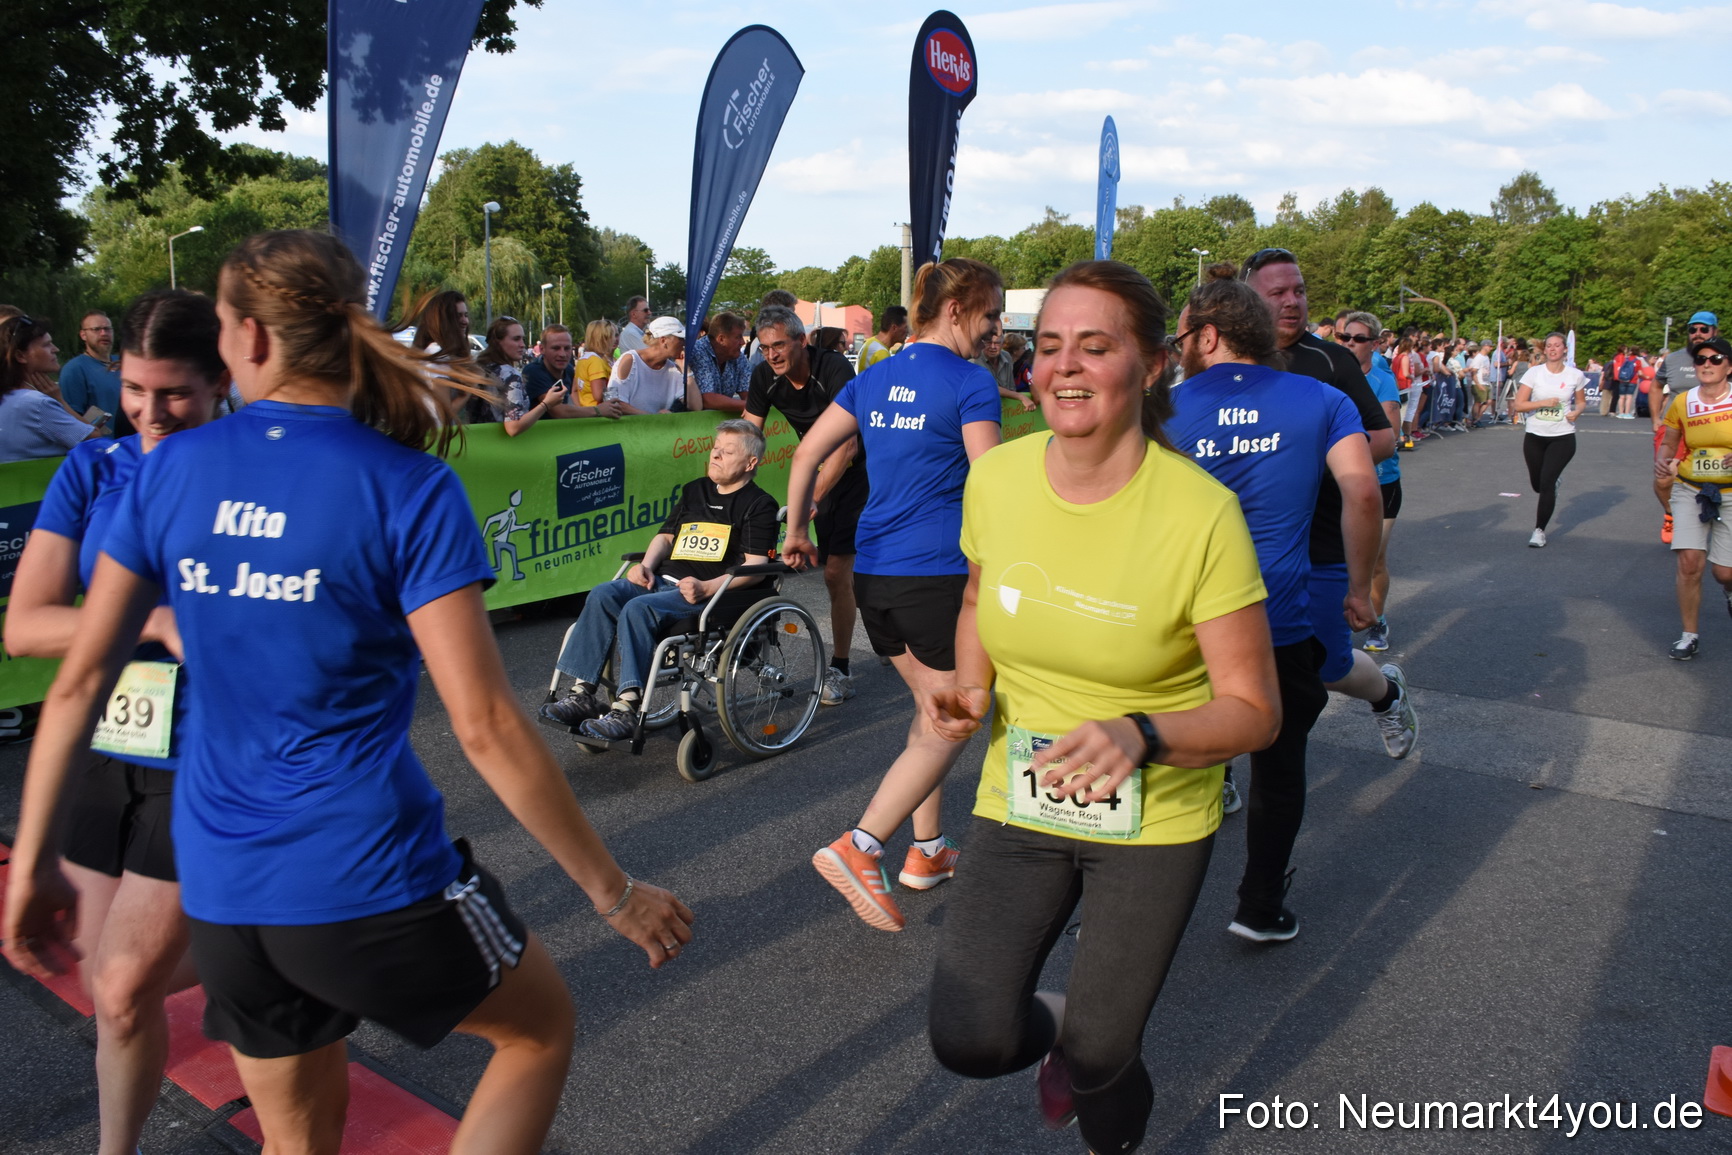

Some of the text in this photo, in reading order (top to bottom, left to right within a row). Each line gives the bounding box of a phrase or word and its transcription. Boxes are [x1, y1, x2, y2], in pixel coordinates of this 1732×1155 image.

[930, 39, 970, 82] Hervis
[733, 58, 770, 136] Fischer
[747, 72, 776, 135] AUTOMOBILE
[365, 74, 443, 312] ww.fischer-automobile.de
[888, 385, 917, 403] Kita
[869, 411, 926, 430] St. Josef
[1218, 407, 1259, 426] Kita
[1539, 409, 1560, 417] 1312
[1687, 417, 1711, 428] MAX
[1195, 432, 1280, 458] St. Josef
[570, 467, 616, 484] Fischer
[574, 477, 611, 490] AUTOMOBILE
[212, 500, 287, 539] Kita
[529, 484, 682, 557] firmenlauf
[682, 535, 720, 552] 1993
[535, 543, 603, 573] neumarkt
[178, 558, 321, 602] St. Josef
[102, 695, 154, 728] 39
[1039, 801, 1102, 821] Wagner Rosi
